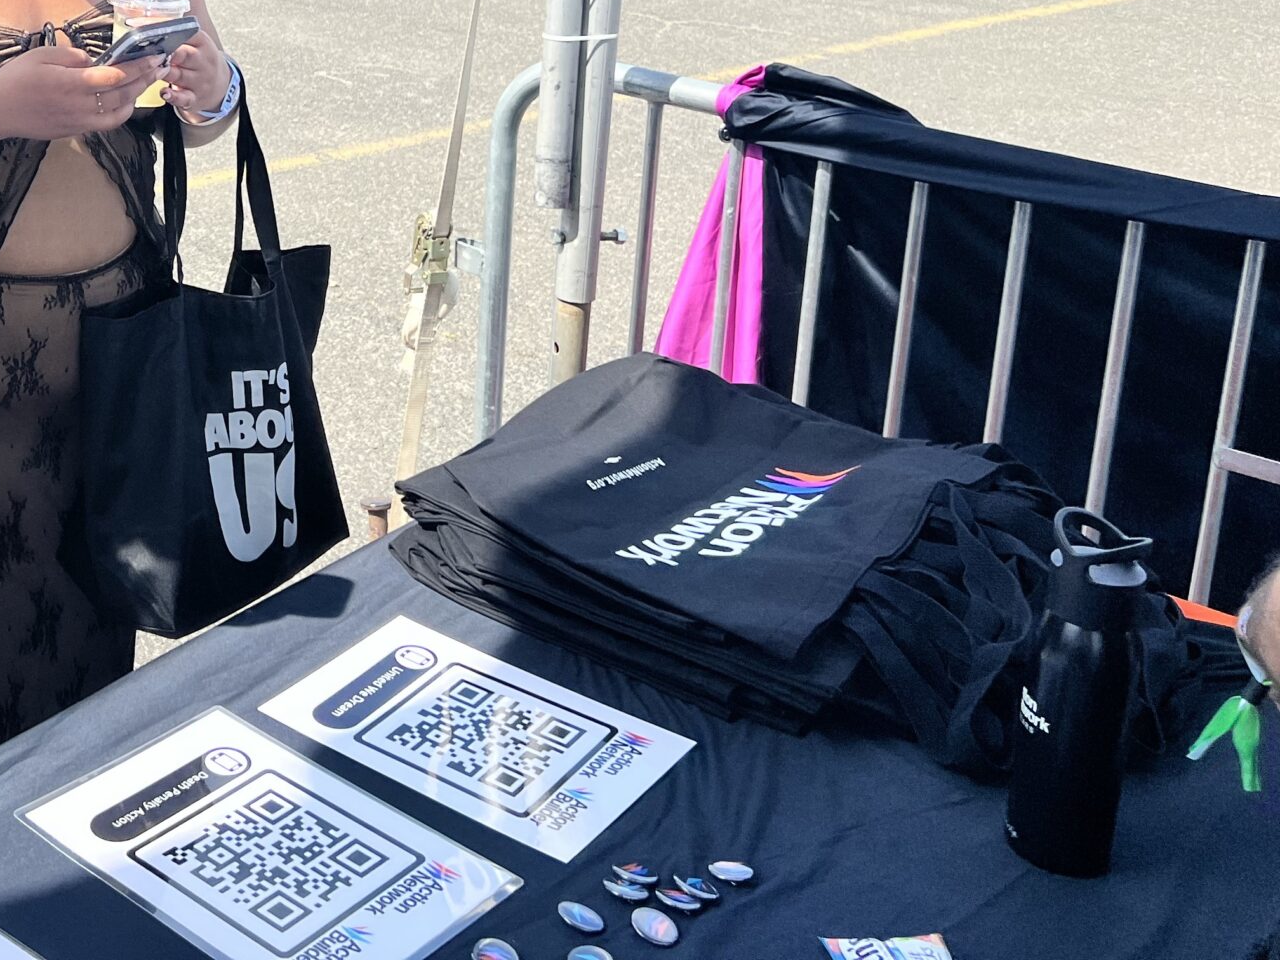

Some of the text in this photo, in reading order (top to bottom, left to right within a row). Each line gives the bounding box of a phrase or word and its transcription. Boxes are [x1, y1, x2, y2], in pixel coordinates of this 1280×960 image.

[586, 457, 666, 490] ActionNetwork.org
[614, 487, 788, 567] Network
[698, 493, 824, 557] Action
[331, 666, 404, 717] United We Dream
[579, 739, 629, 778] Network
[604, 745, 643, 776] Action
[111, 771, 209, 828] Death Penalty Action
[530, 792, 575, 827] Builder
[547, 799, 588, 831] Action
[364, 870, 431, 915] Network
[394, 879, 444, 914] Action
